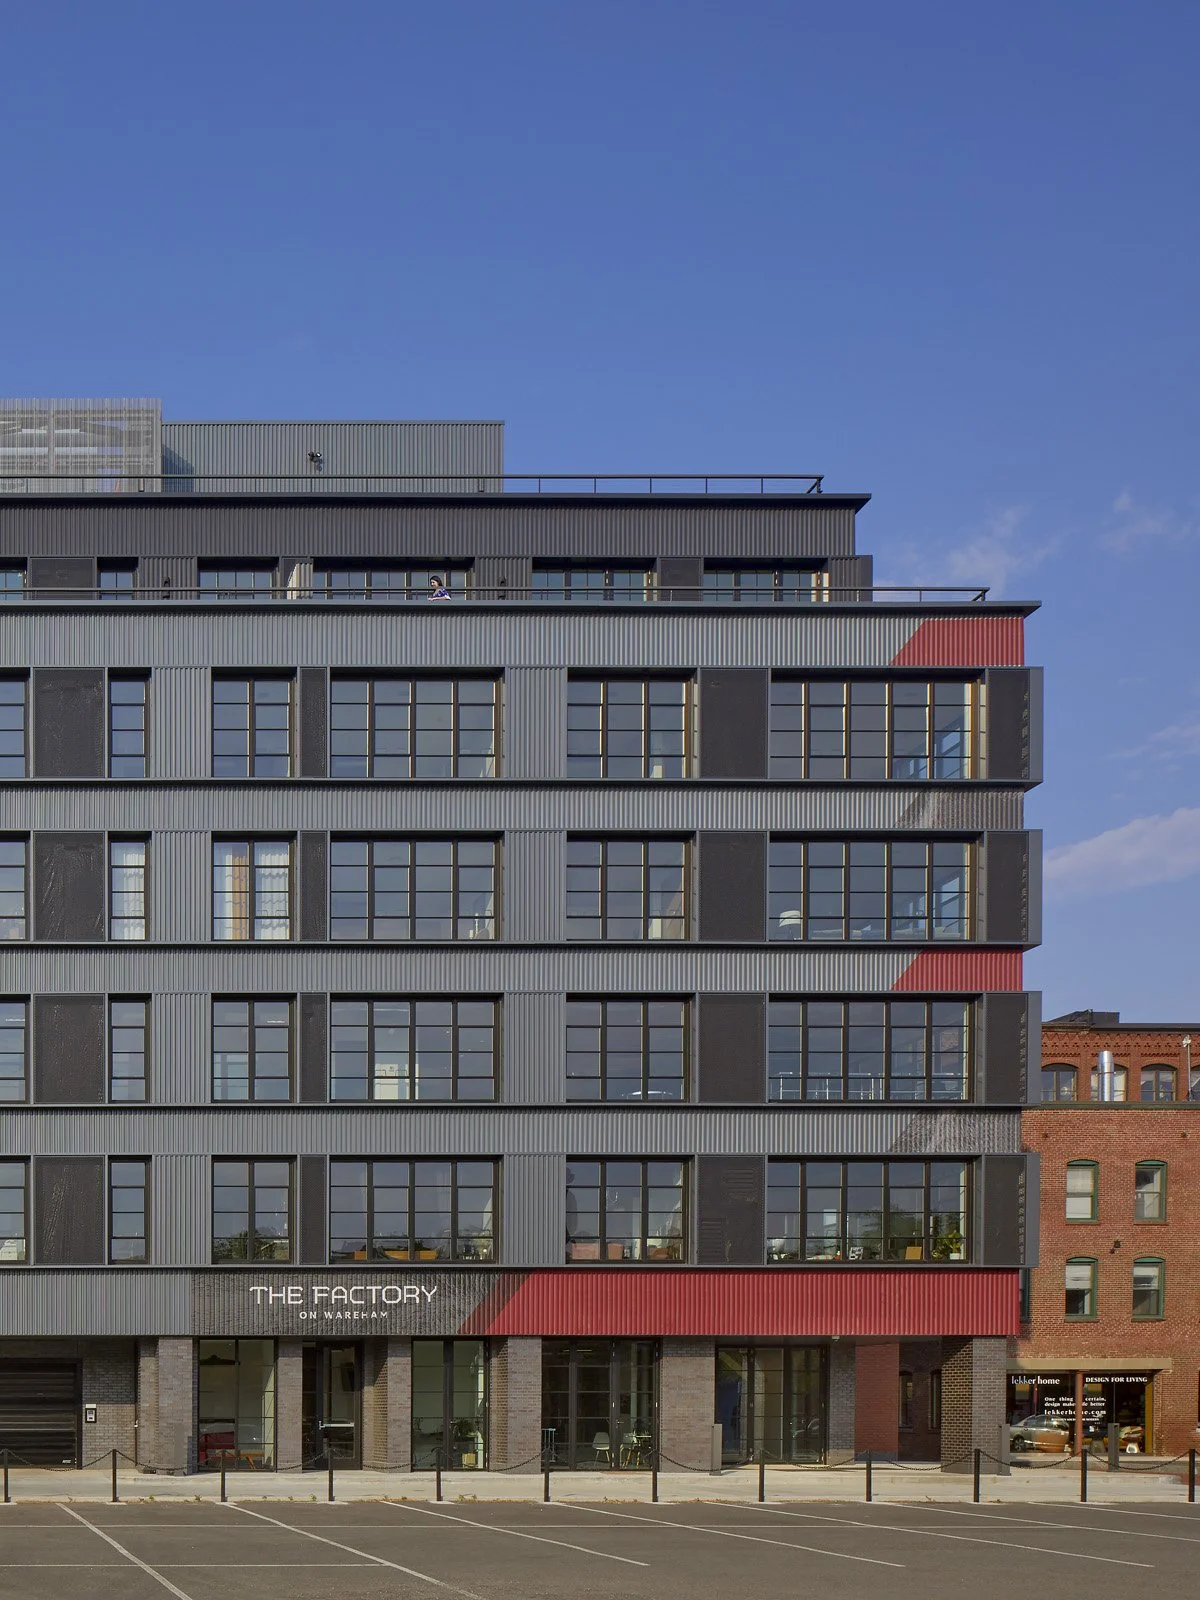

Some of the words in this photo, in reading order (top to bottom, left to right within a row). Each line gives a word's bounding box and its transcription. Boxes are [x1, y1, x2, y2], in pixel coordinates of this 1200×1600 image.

[249, 1286, 303, 1305] THE
[312, 1285, 438, 1304] FACTORY
[299, 1311, 317, 1320] ON
[324, 1311, 388, 1320] WAREHAM
[1011, 1375, 1036, 1385] lekker
[1037, 1375, 1060, 1385] home
